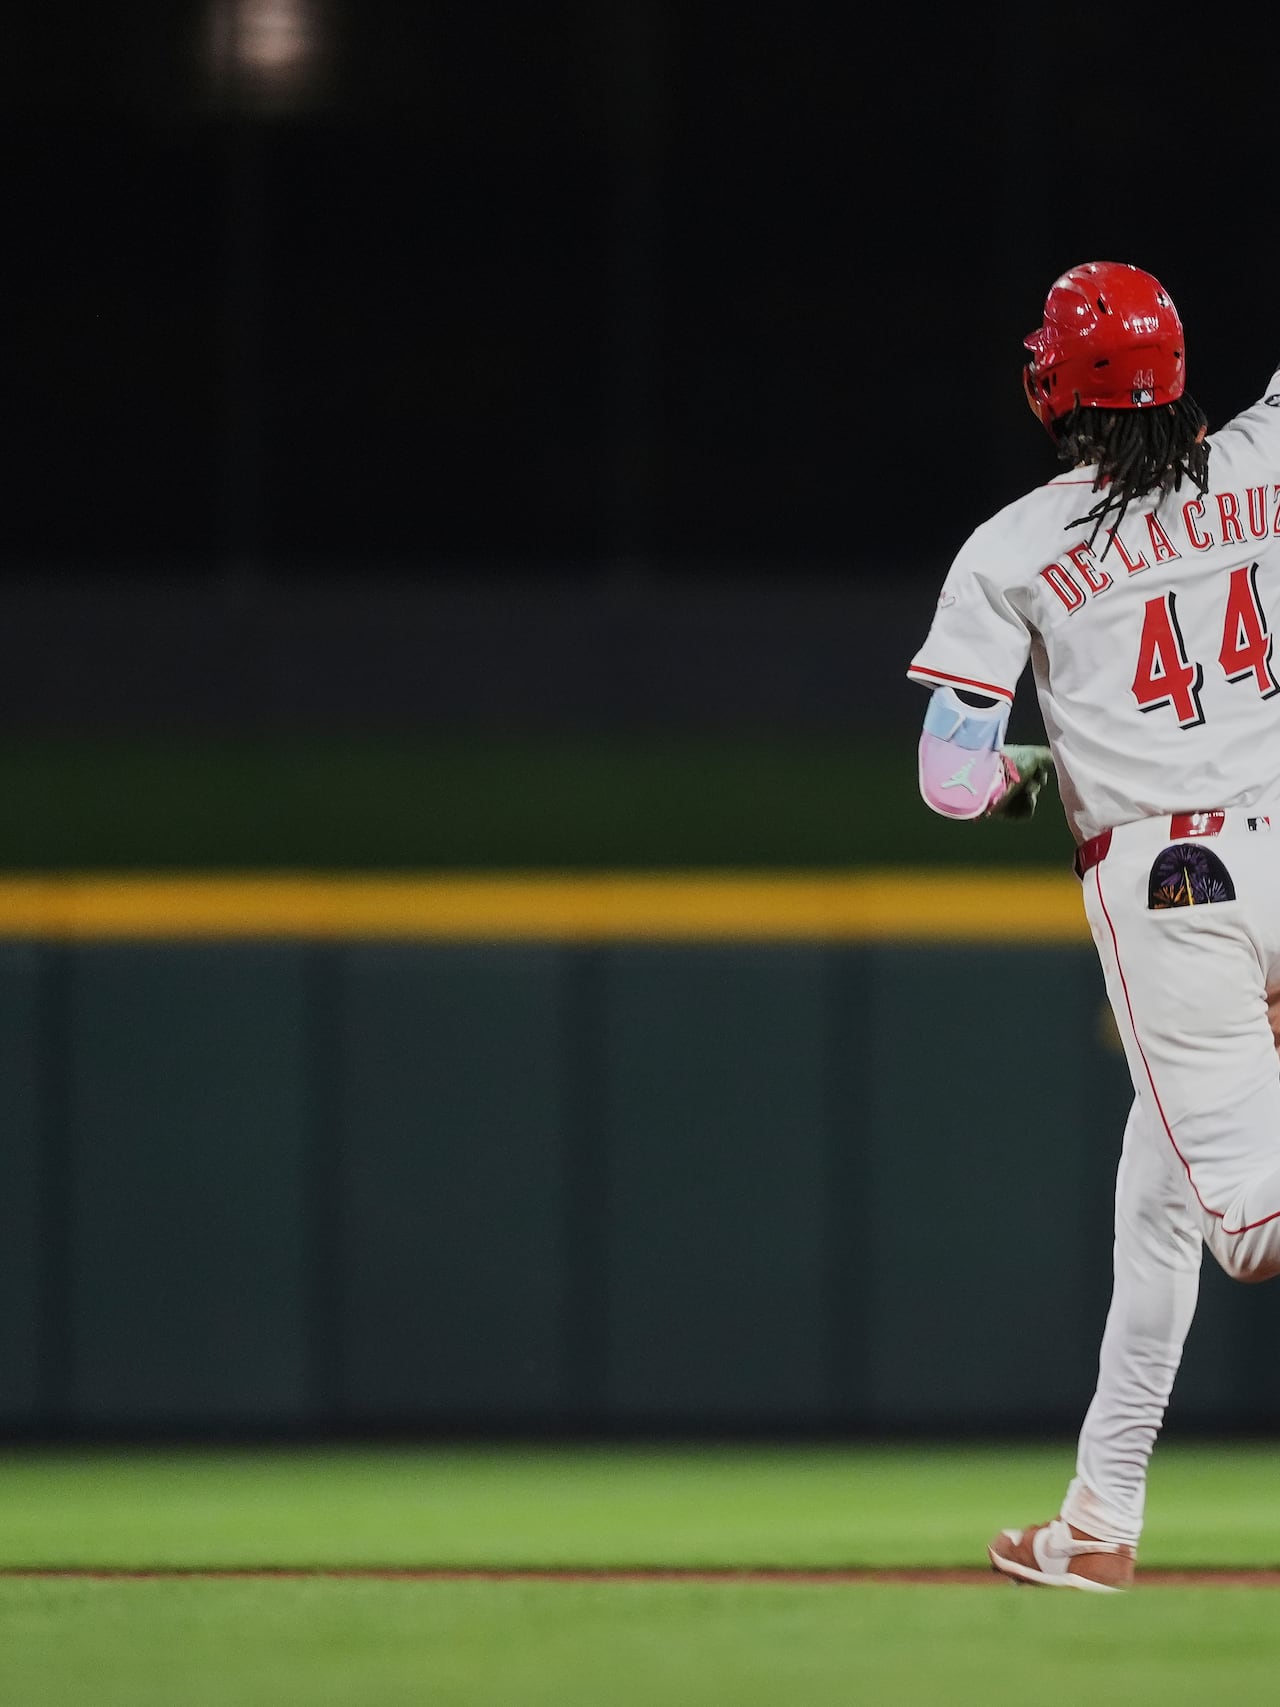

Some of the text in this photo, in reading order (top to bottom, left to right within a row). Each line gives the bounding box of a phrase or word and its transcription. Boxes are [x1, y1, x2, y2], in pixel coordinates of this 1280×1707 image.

[1133, 369, 1154, 388] 44
[1040, 541, 1113, 616] DE
[1106, 512, 1182, 577] LA
